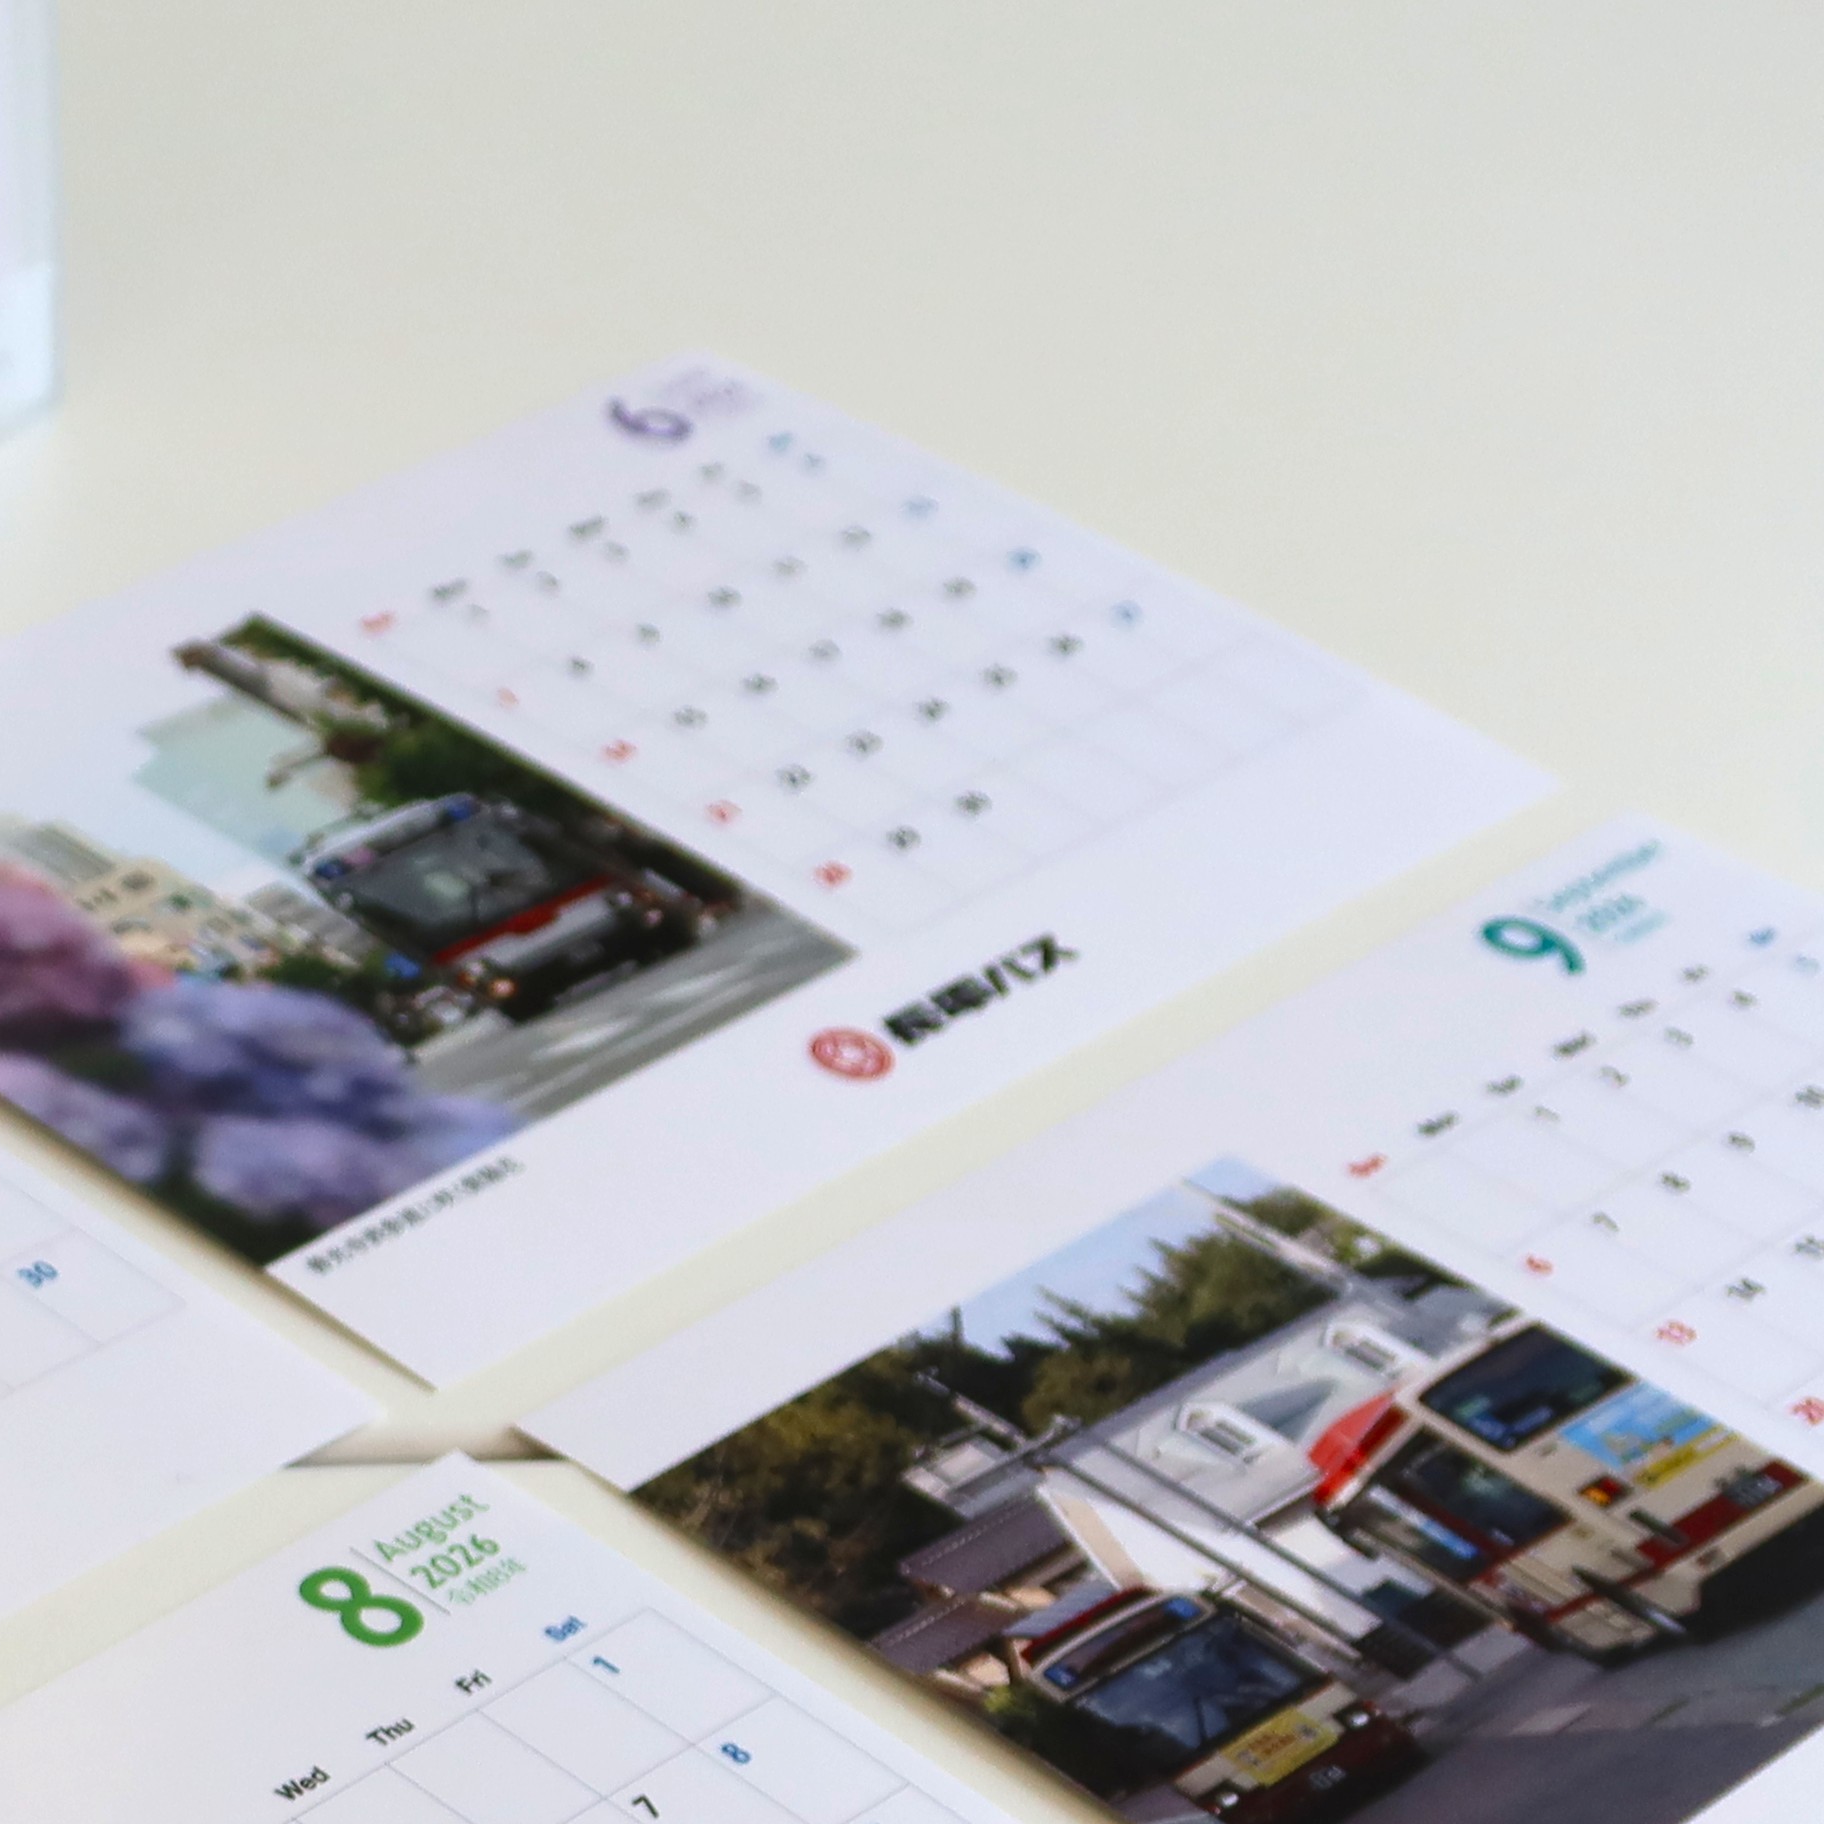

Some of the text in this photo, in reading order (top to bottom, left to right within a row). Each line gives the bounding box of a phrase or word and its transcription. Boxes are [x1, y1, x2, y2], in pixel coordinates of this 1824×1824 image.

[1481, 916, 1585, 974] 9
[17, 1261, 59, 1289] 30
[374, 1495, 488, 1563] August
[410, 1535, 500, 1589] 2026
[298, 1567, 424, 1648] 8
[273, 1764, 332, 1802] Wed
[364, 1717, 416, 1747] Thu
